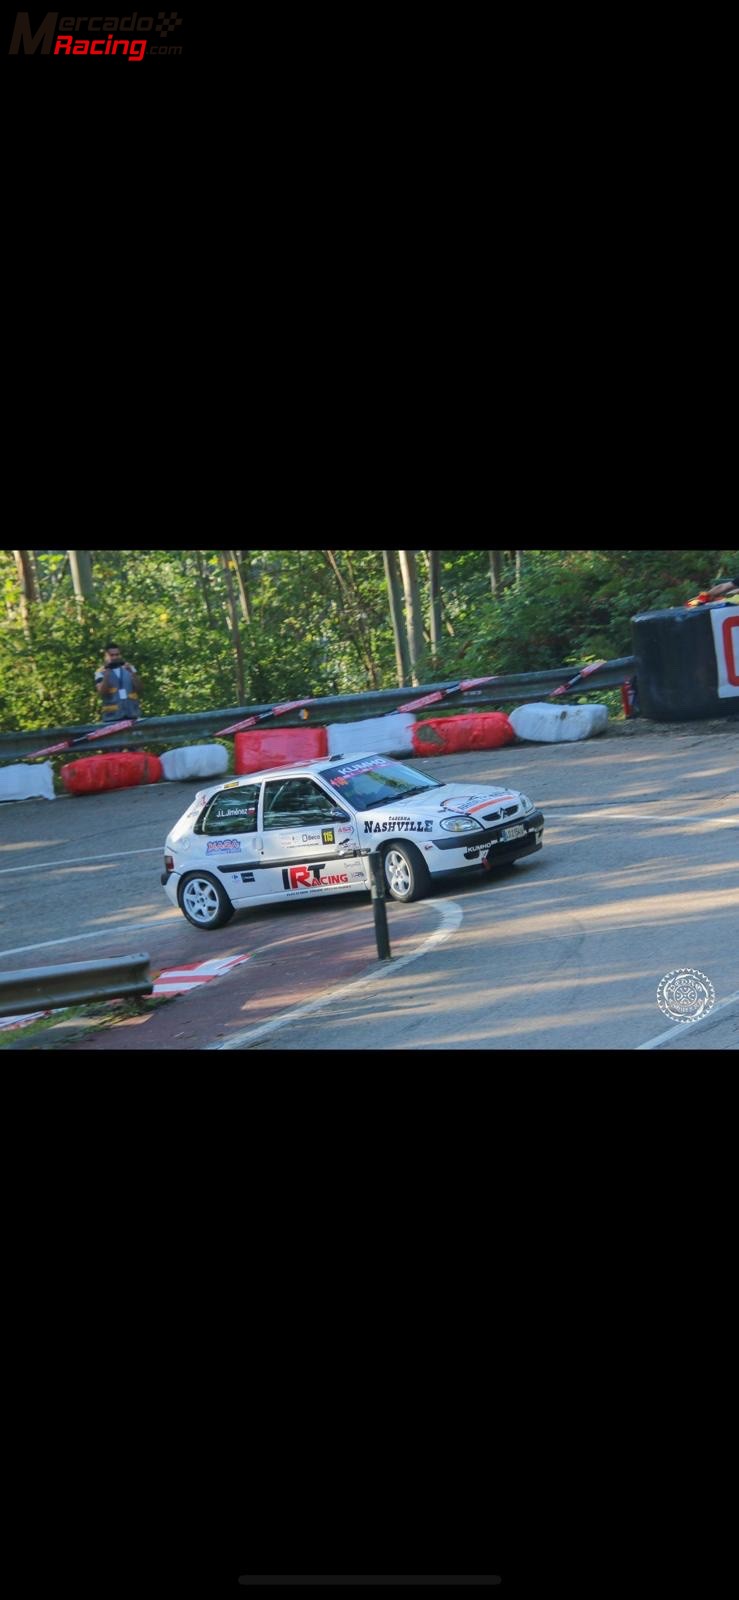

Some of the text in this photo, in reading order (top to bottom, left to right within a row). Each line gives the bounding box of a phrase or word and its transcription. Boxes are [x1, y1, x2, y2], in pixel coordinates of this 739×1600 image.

[338, 759, 386, 774] KUMHO
[364, 820, 434, 833] NASHVILLE
[466, 842, 492, 853] KUMHO
